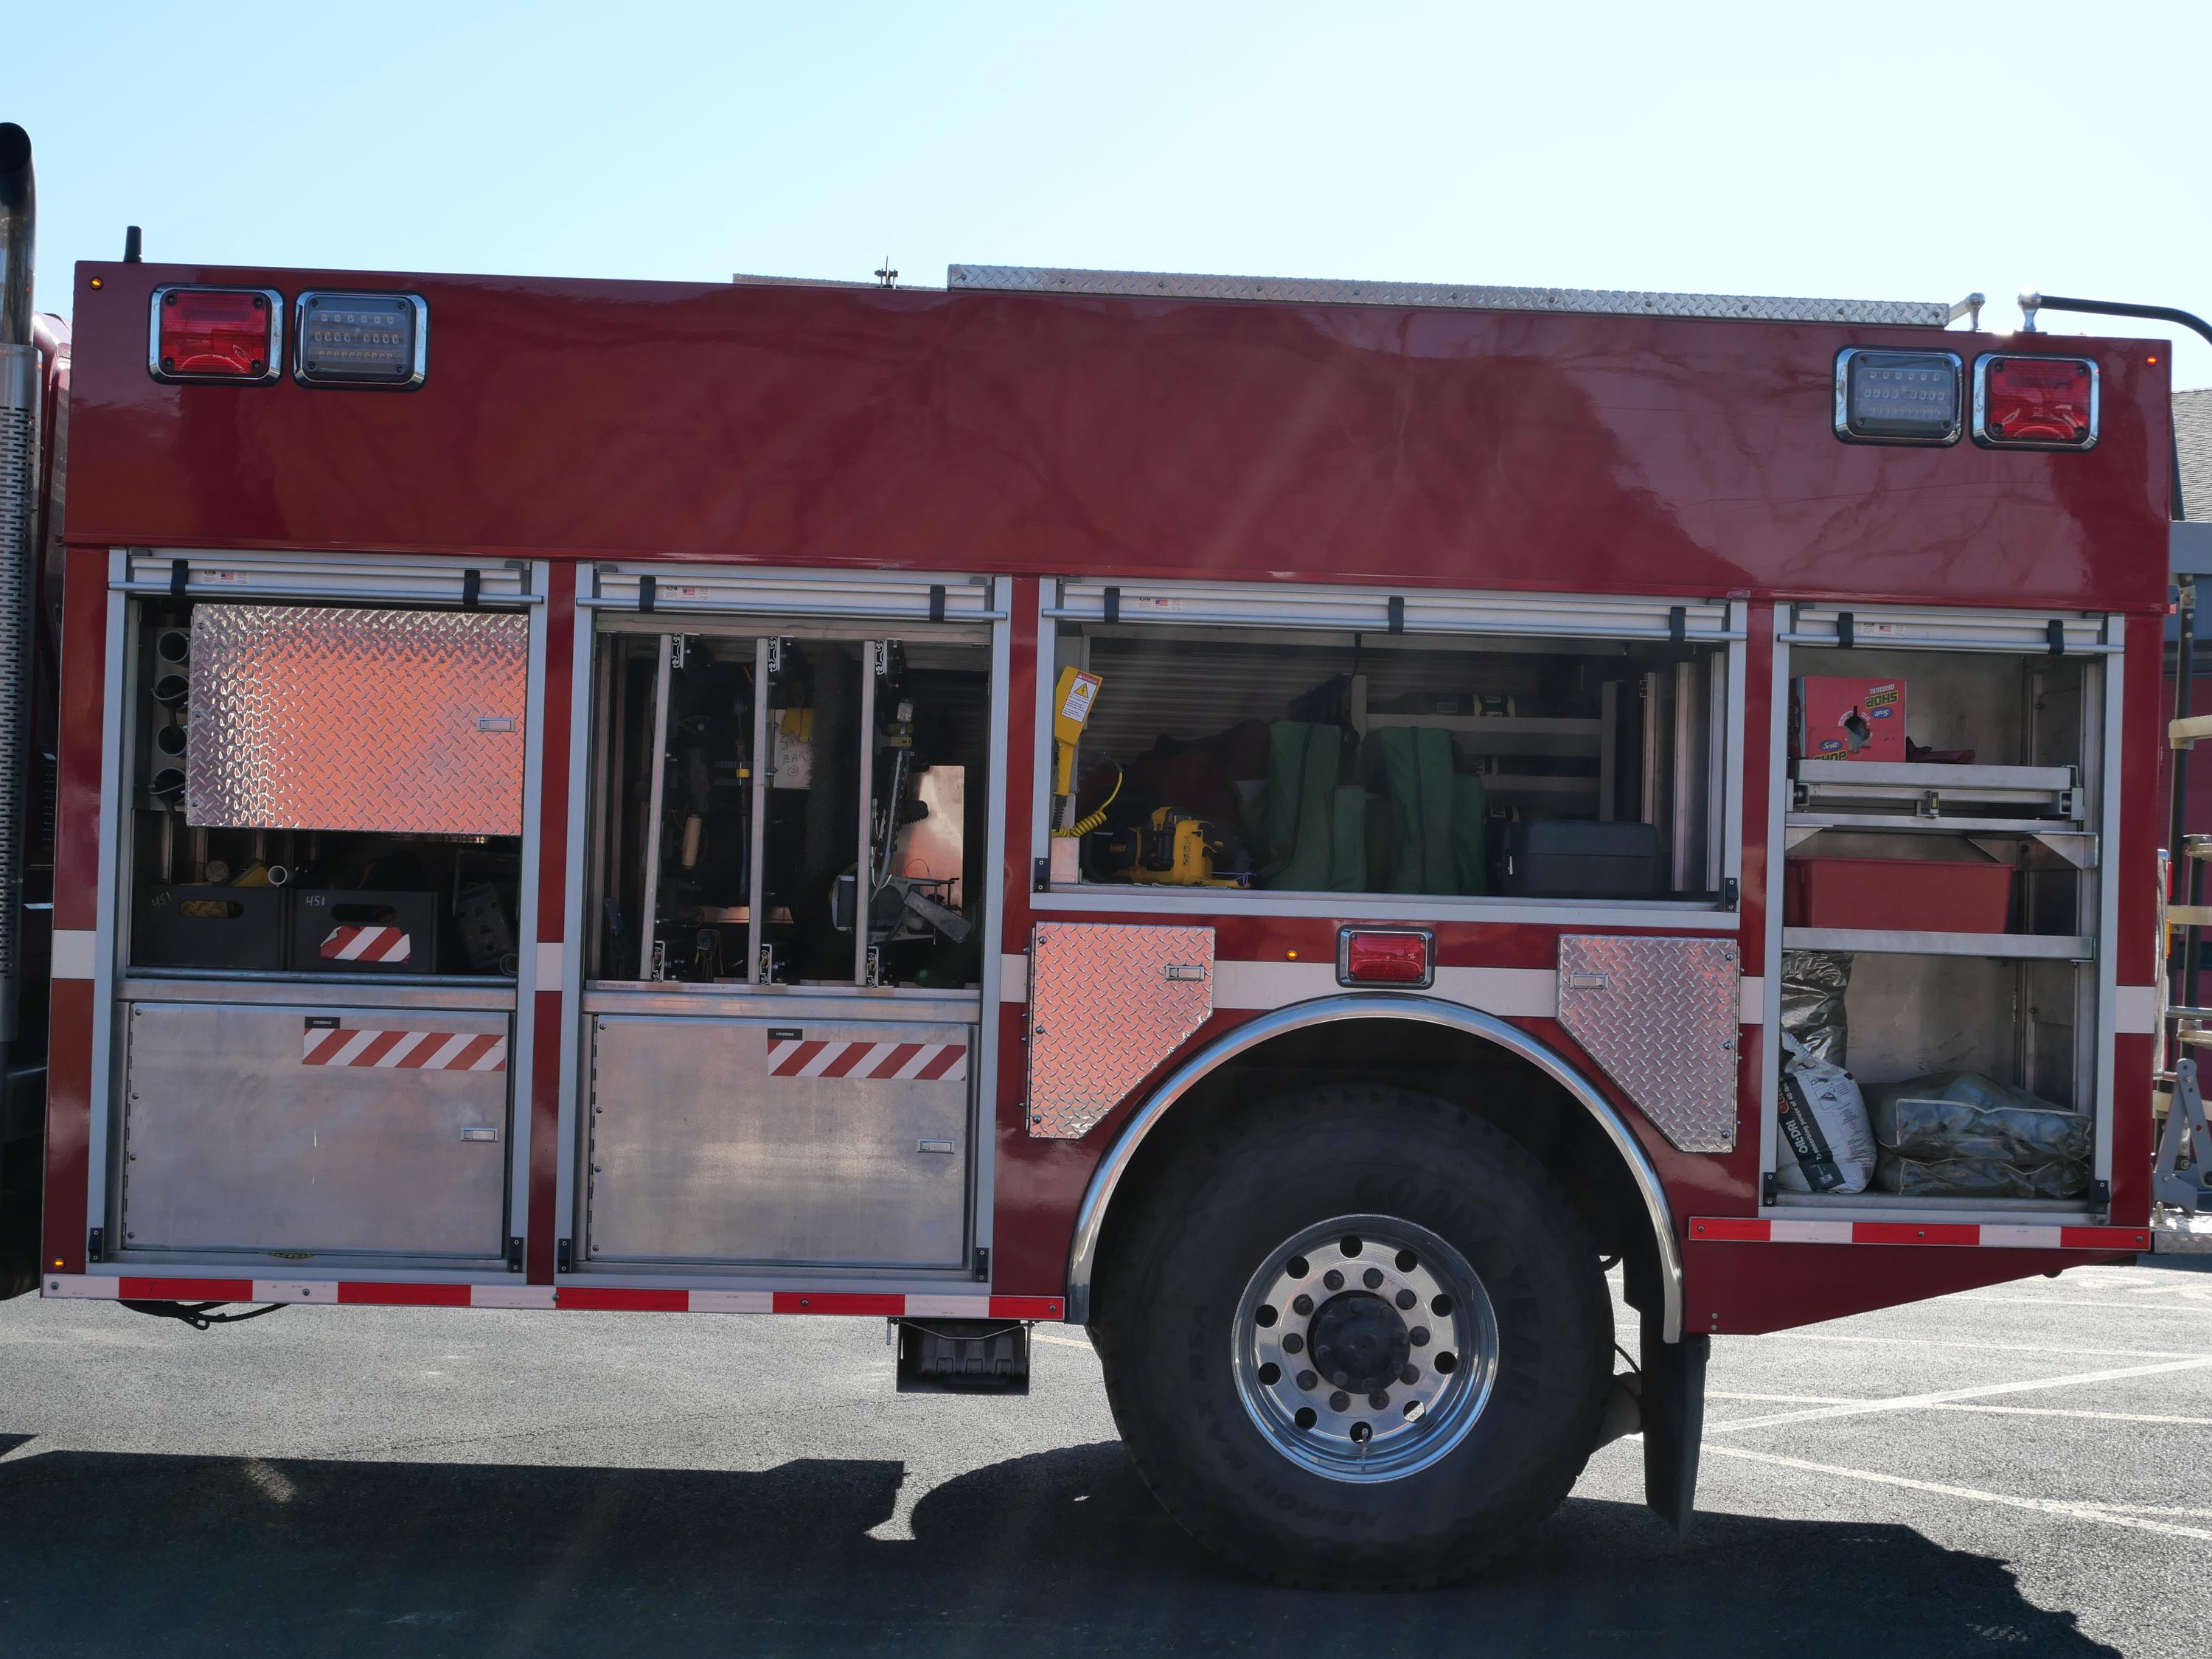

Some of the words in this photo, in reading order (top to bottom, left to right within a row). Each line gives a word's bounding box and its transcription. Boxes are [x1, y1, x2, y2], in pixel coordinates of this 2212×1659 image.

[1869, 684, 1895, 695] ORIGINAL
[1865, 690, 1899, 709] SHOP
[1874, 709, 1890, 717] Scott
[1823, 741, 1839, 750] Scott
[152, 891, 172, 909] 451
[306, 894, 325, 906] 451
[1787, 1091, 1794, 1101] 40
[1794, 1107, 1805, 1126] power
[1803, 1124, 1820, 1155] absorbing
[1354, 1171, 1545, 1408] GOODYEAR
[1197, 1393, 1248, 1472] MAX
[1252, 1478, 1384, 1528] ARMOR
